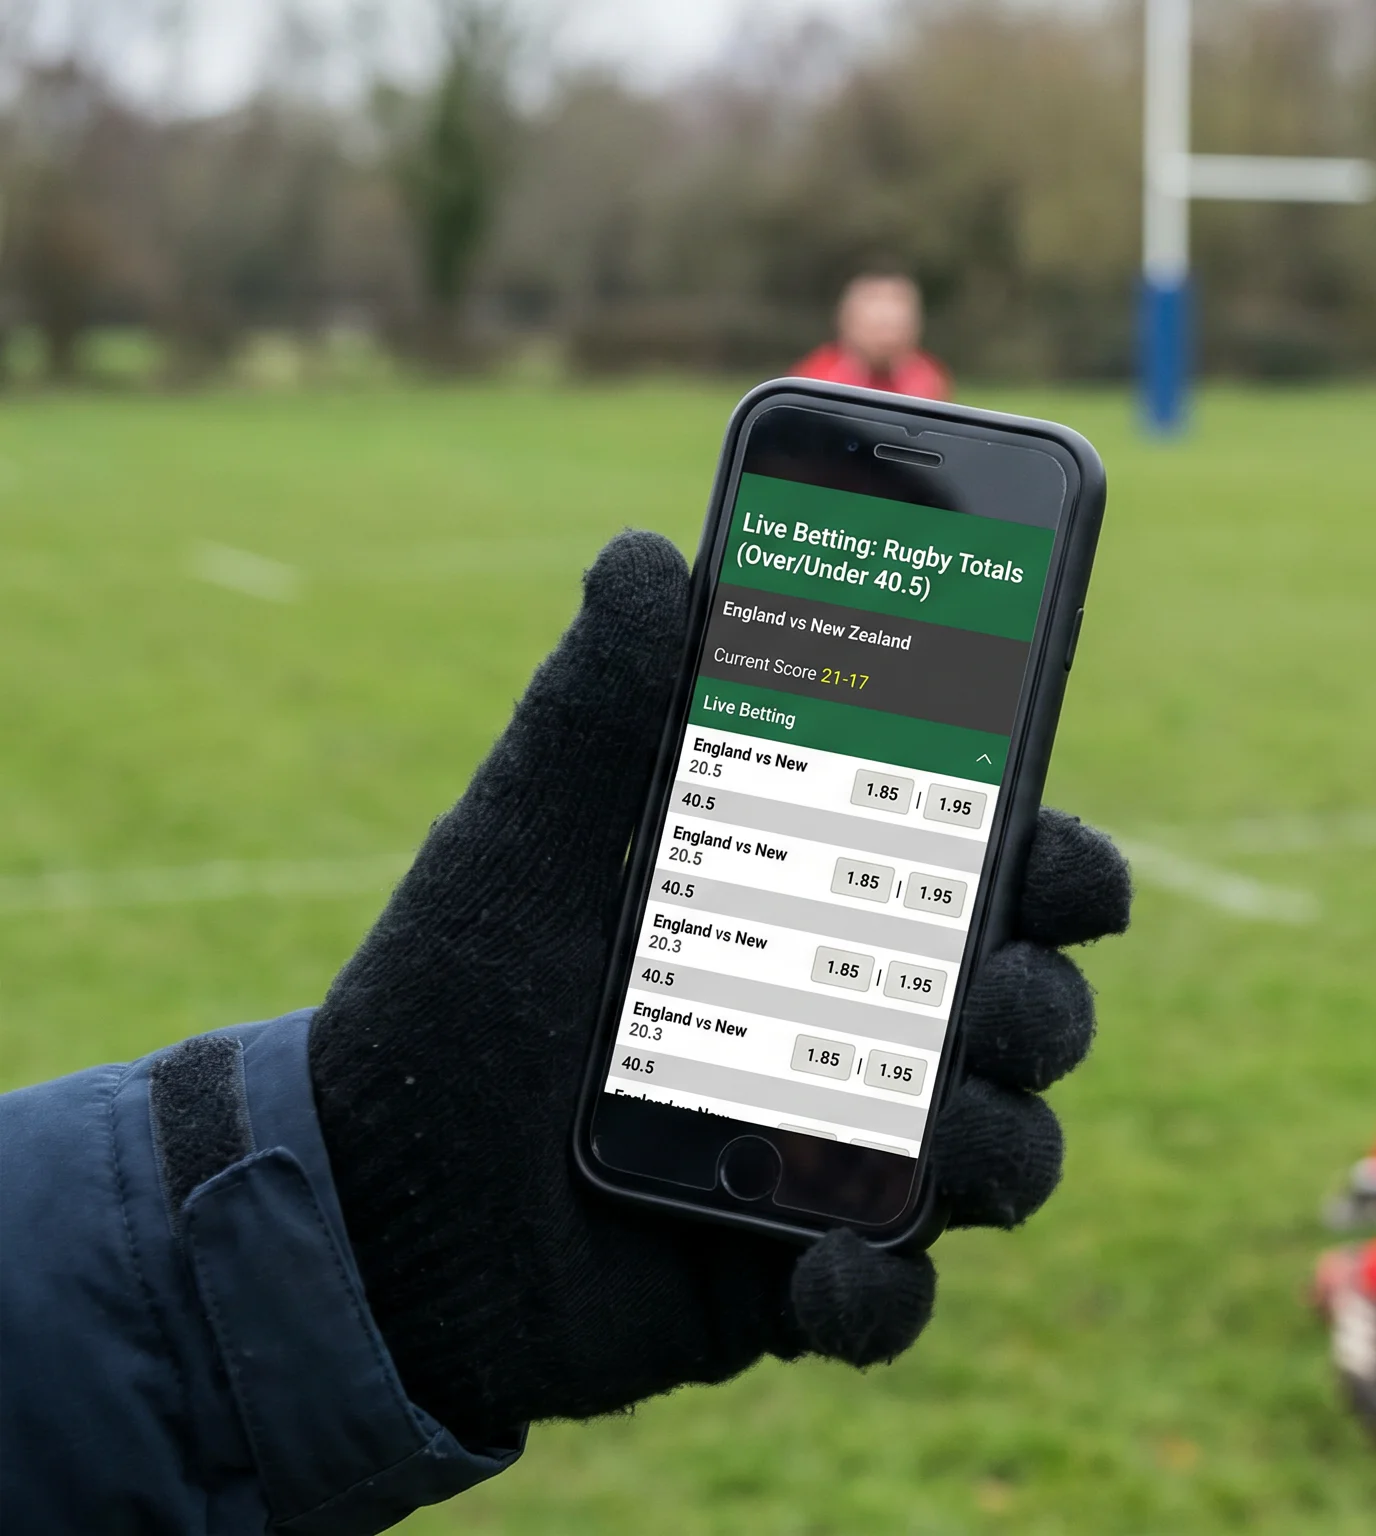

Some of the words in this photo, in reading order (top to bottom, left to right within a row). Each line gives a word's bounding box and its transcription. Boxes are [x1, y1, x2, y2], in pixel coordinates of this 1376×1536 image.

[743, 512, 787, 538] Live
[793, 522, 877, 559] Betting:
[883, 539, 953, 574] Rugby
[959, 552, 1023, 583] Totals
[737, 542, 869, 585] (Over/Under
[874, 570, 930, 602] 40.5)
[723, 601, 786, 626] England
[790, 617, 807, 630] vs
[810, 618, 845, 637] New
[848, 625, 912, 650] Zealand
[714, 648, 770, 671] Current
[773, 659, 817, 680] Score
[821, 668, 869, 689] 21-17
[703, 695, 735, 714] Live
[739, 702, 796, 730] Betting
[689, 759, 723, 777] 20.5
[693, 737, 752, 761] England
[756, 753, 772, 765] vs
[775, 753, 808, 772] New
[682, 792, 716, 810] 40.5
[867, 783, 899, 801] 1.85
[940, 797, 972, 815] 1.95
[669, 847, 703, 865] 20.5
[673, 825, 732, 850] England
[736, 841, 752, 854] vs
[755, 842, 788, 861] New
[661, 880, 695, 898] 40.5
[848, 871, 880, 889] 1.85
[921, 886, 952, 904] 1.95
[648, 935, 682, 953] 20.3
[653, 914, 713, 938] England
[716, 929, 731, 942] vs
[735, 930, 768, 949] New
[641, 968, 675, 986] 40.5
[828, 961, 859, 978] 1.85
[900, 975, 932, 993] 1.95
[629, 1022, 663, 1041] 20.3
[633, 1001, 693, 1026] England
[696, 1017, 712, 1030] vs
[715, 1019, 748, 1037] New
[621, 1056, 655, 1074] 40.5
[808, 1048, 840, 1066] 1.85
[881, 1063, 913, 1082] 1.95
